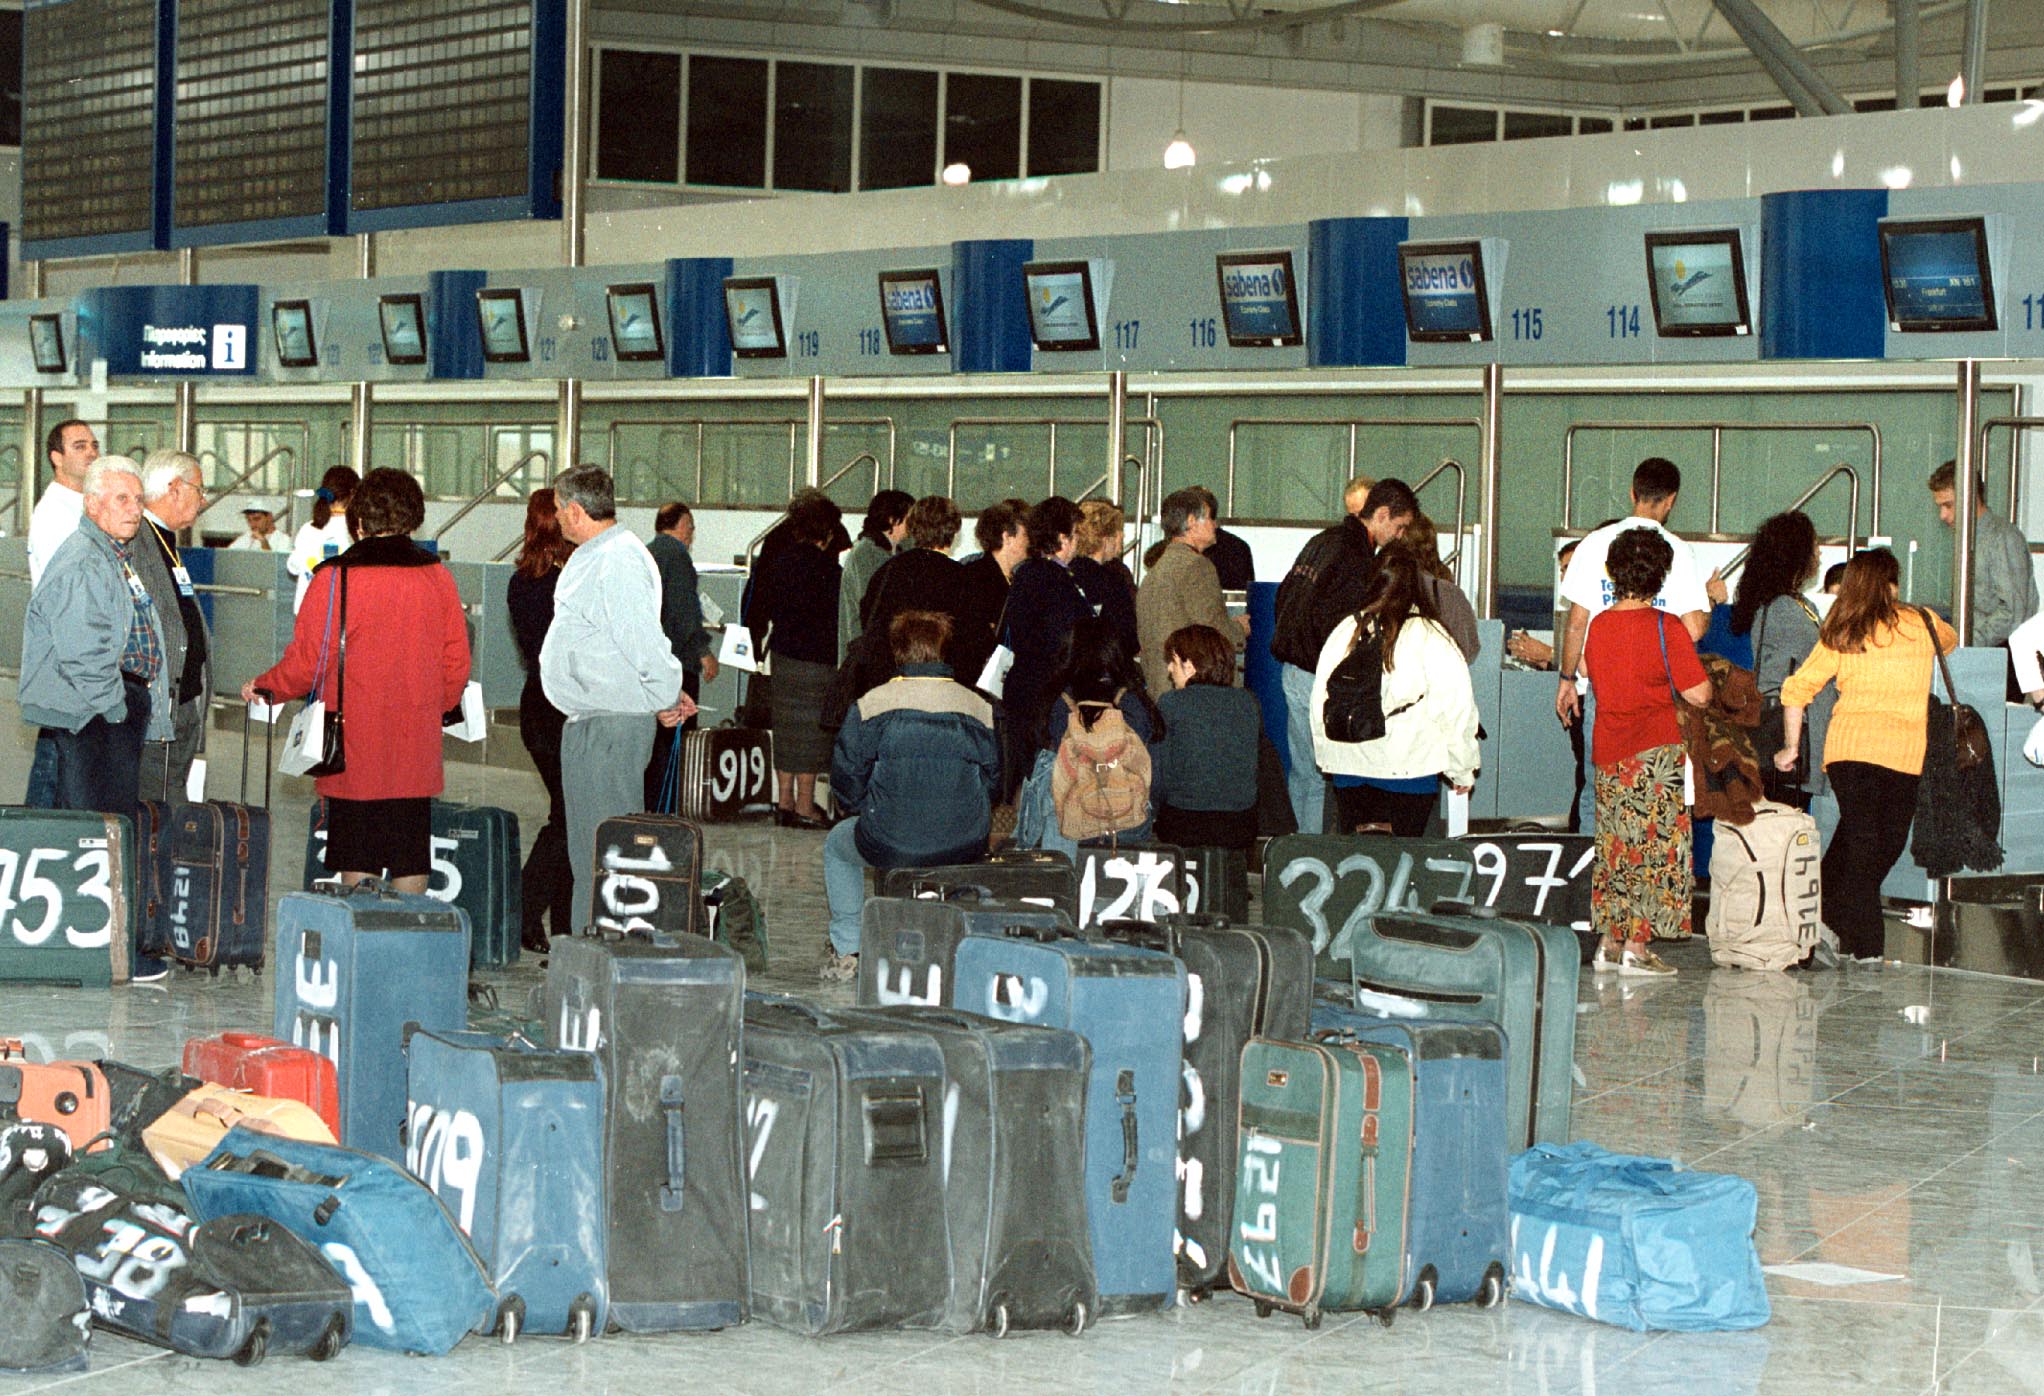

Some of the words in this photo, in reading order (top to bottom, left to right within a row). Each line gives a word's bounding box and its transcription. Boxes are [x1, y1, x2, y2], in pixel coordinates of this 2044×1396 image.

[1225, 270, 1271, 297] sabena
[1407, 261, 1458, 290] sabena
[1114, 320, 1140, 349] 117
[1190, 318, 1216, 348] 116
[1511, 307, 1543, 341] 115
[1607, 305, 1641, 339] 114
[591, 336, 608, 361] 120
[798, 331, 819, 357] 119
[859, 329, 881, 356] 118
[141, 350, 206, 369] Information
[712, 746, 766, 803] 919
